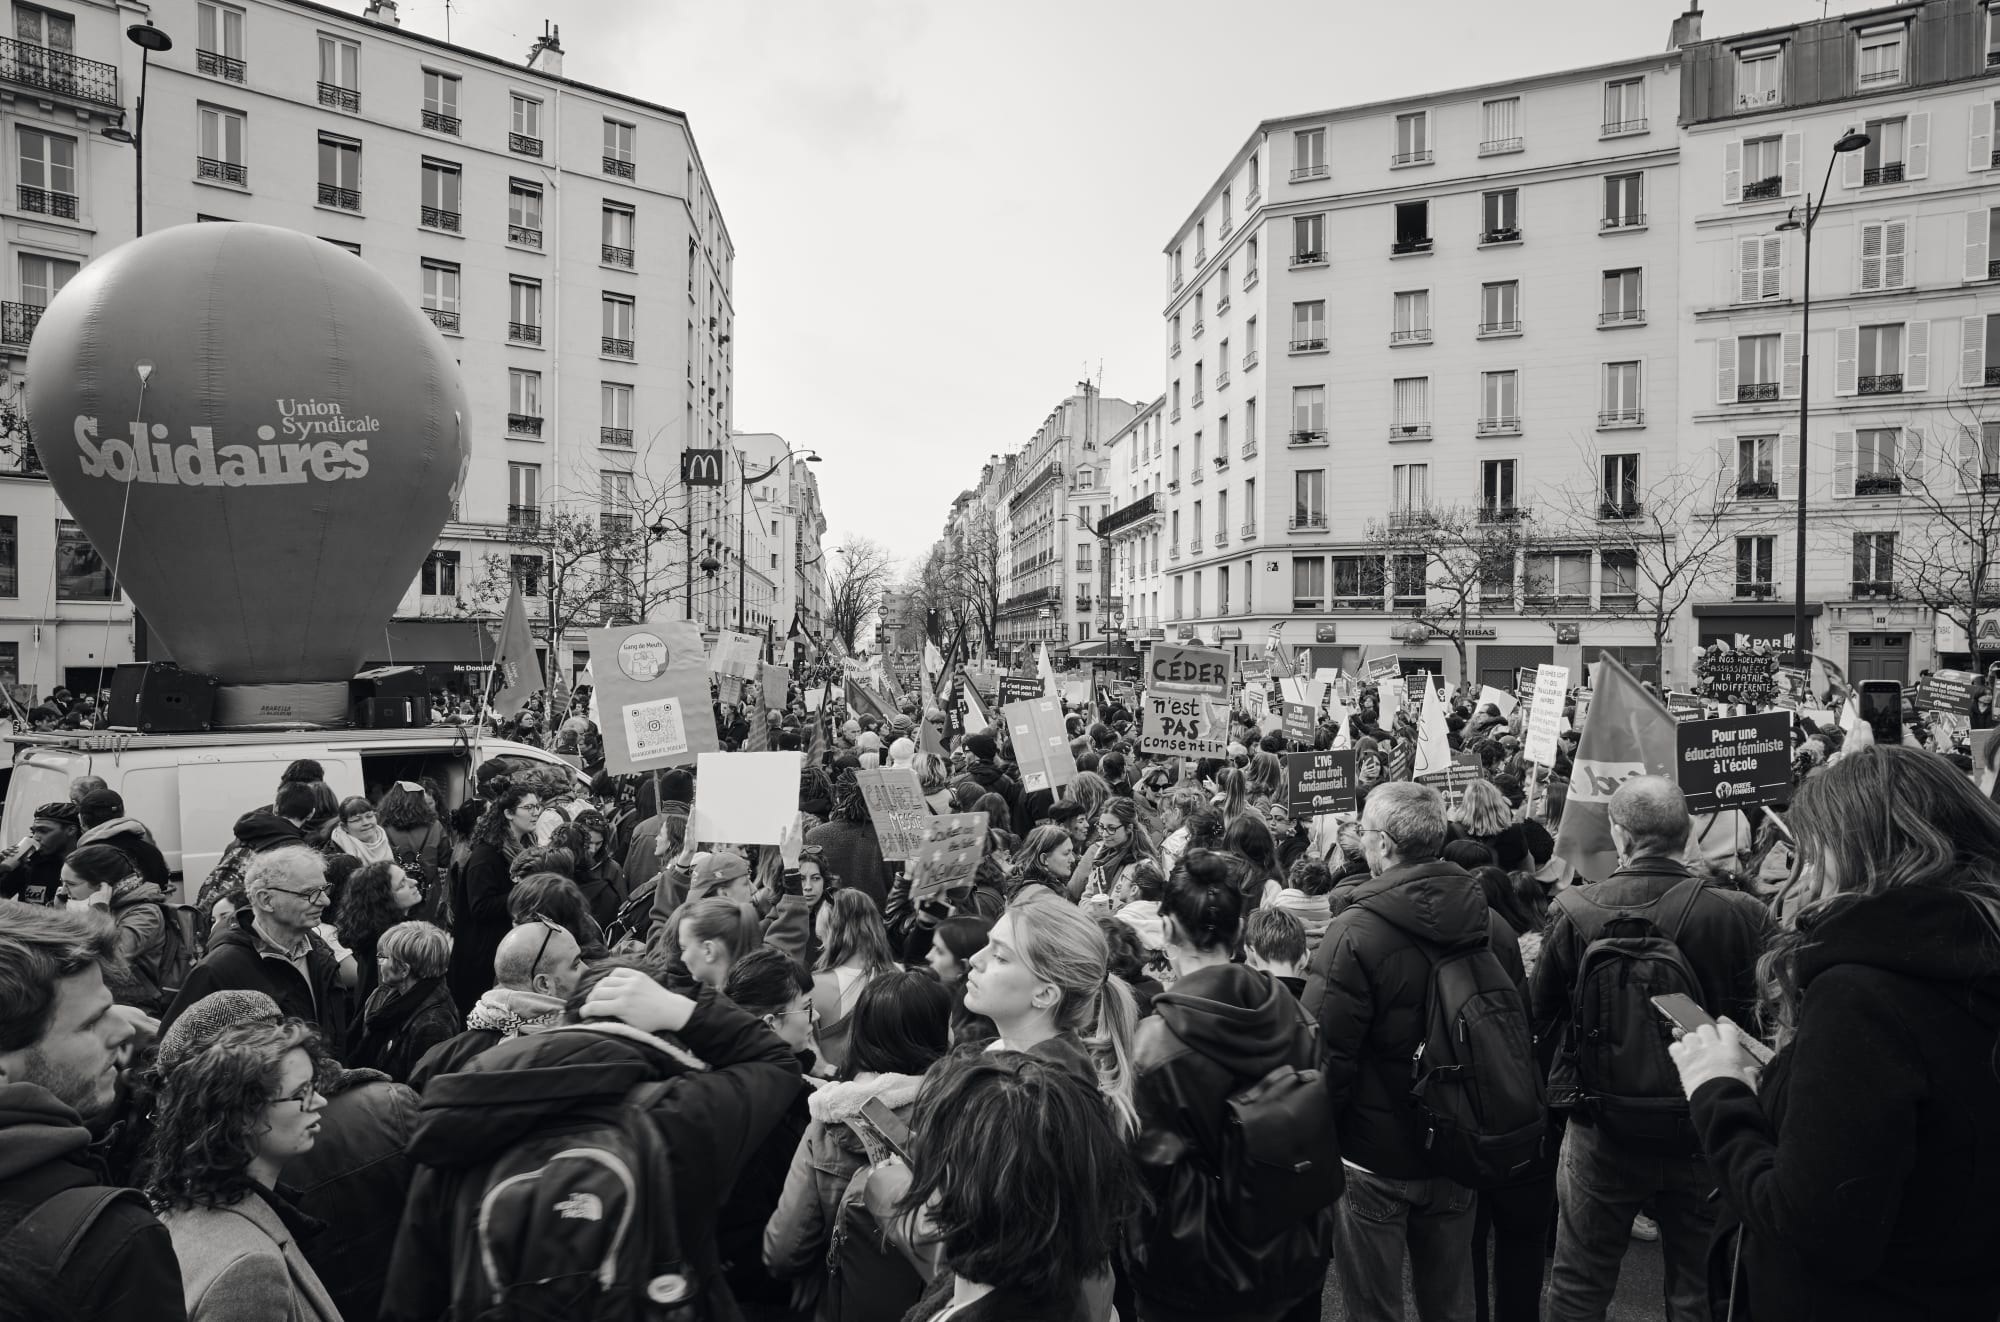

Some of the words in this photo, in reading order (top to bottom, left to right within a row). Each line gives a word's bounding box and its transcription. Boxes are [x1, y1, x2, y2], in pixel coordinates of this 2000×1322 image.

[276, 399, 341, 417] Union
[282, 416, 380, 440] Syndicale
[74, 415, 369, 487] Solidaires
[1753, 639, 1781, 648] PAR
[1719, 655, 1734, 663] NOS
[1153, 651, 1226, 685] CÉDER
[1721, 673, 1731, 681] LA
[1735, 673, 1764, 682] PATRIE
[1153, 696, 1200, 716] n'est
[950, 709, 960, 729] Paris
[1160, 717, 1200, 739] PAS
[1712, 729, 1736, 743] Pour
[1738, 728, 1757, 740] une
[1144, 737, 1223, 752] consentir
[1685, 744, 1736, 761] éducation
[1738, 738, 1784, 756] féministe
[1314, 755, 1332, 767] L'IVG
[1714, 760, 1720, 774] à
[1722, 757, 1758, 772] l'école
[1304, 769, 1316, 780] est
[1317, 770, 1326, 779] un
[1327, 766, 1342, 778] droit
[1298, 778, 1343, 792] fondamental
[1344, 777, 1347, 788] !
